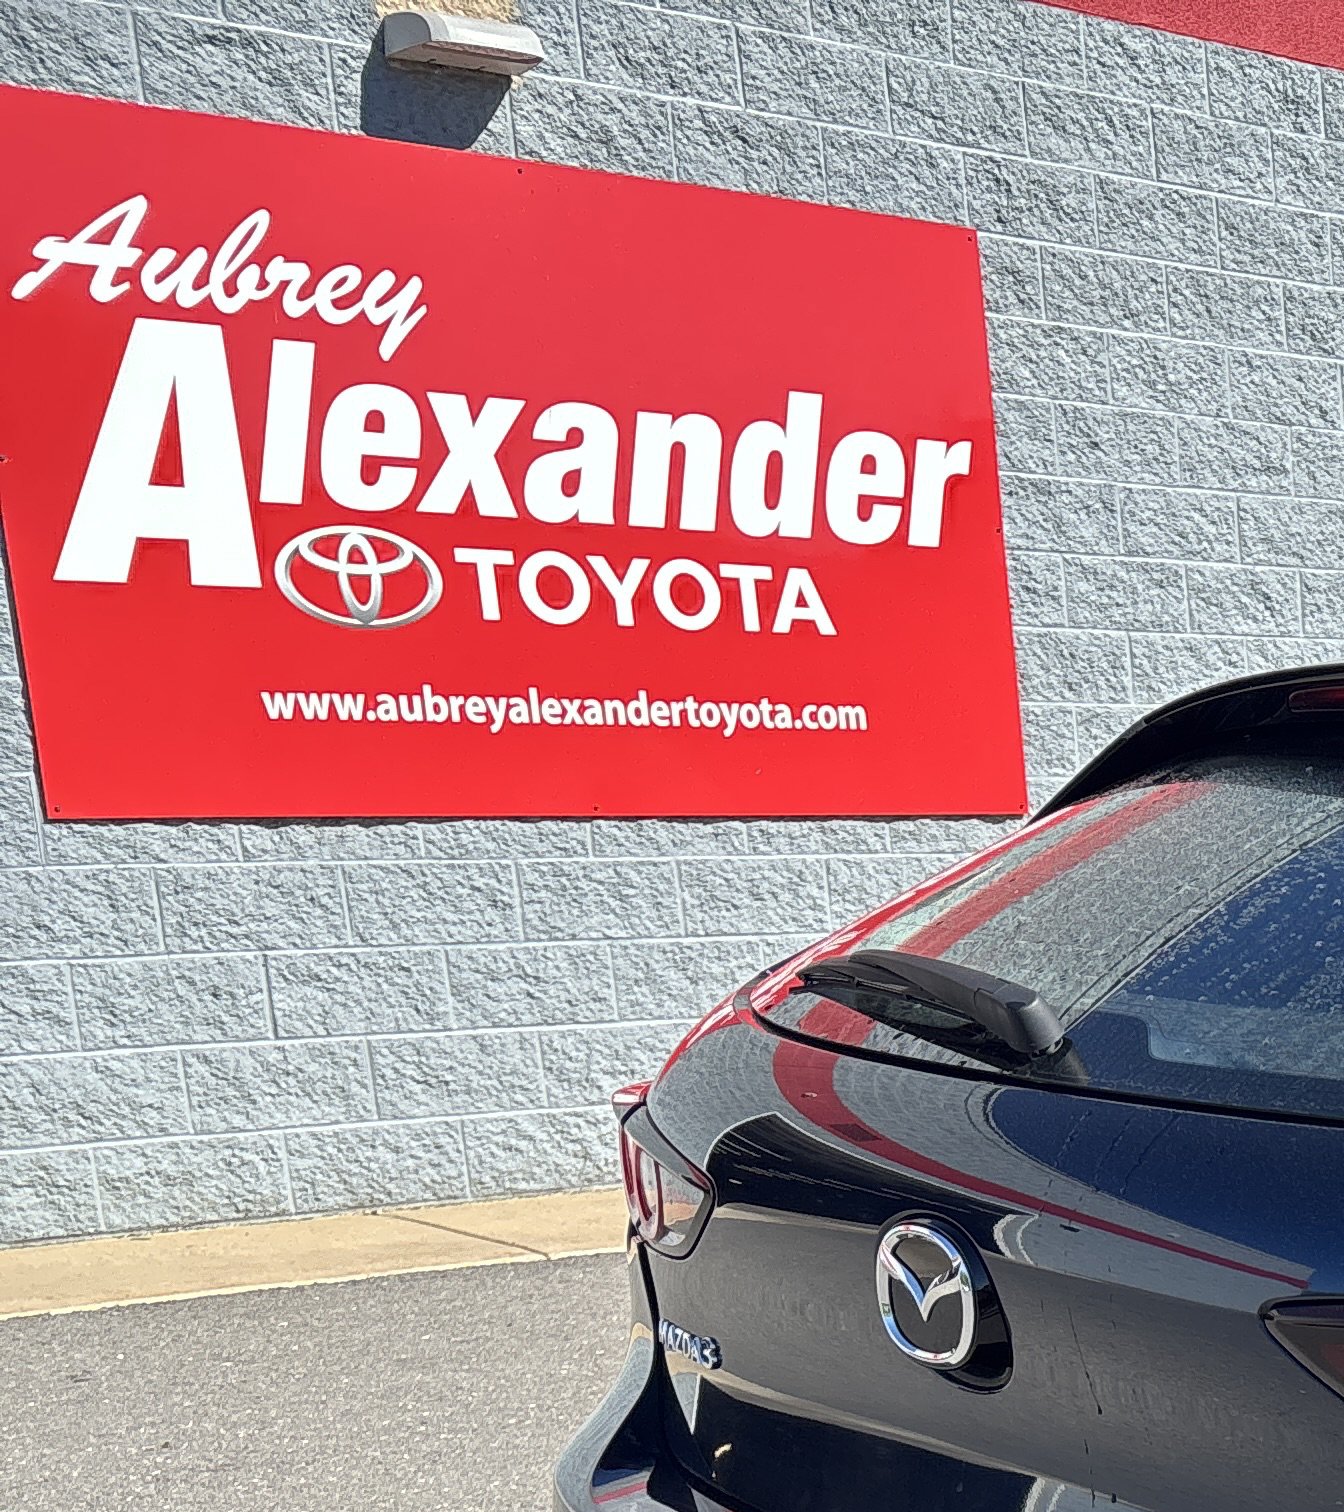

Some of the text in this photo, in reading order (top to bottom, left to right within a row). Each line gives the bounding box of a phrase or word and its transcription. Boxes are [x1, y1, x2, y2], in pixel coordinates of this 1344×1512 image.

[12, 194, 429, 361] Aubrey
[53, 316, 973, 590] Alexander
[453, 547, 839, 637] TOYOTA
[260, 686, 868, 739] www.aubreyalexandertoyota.com
